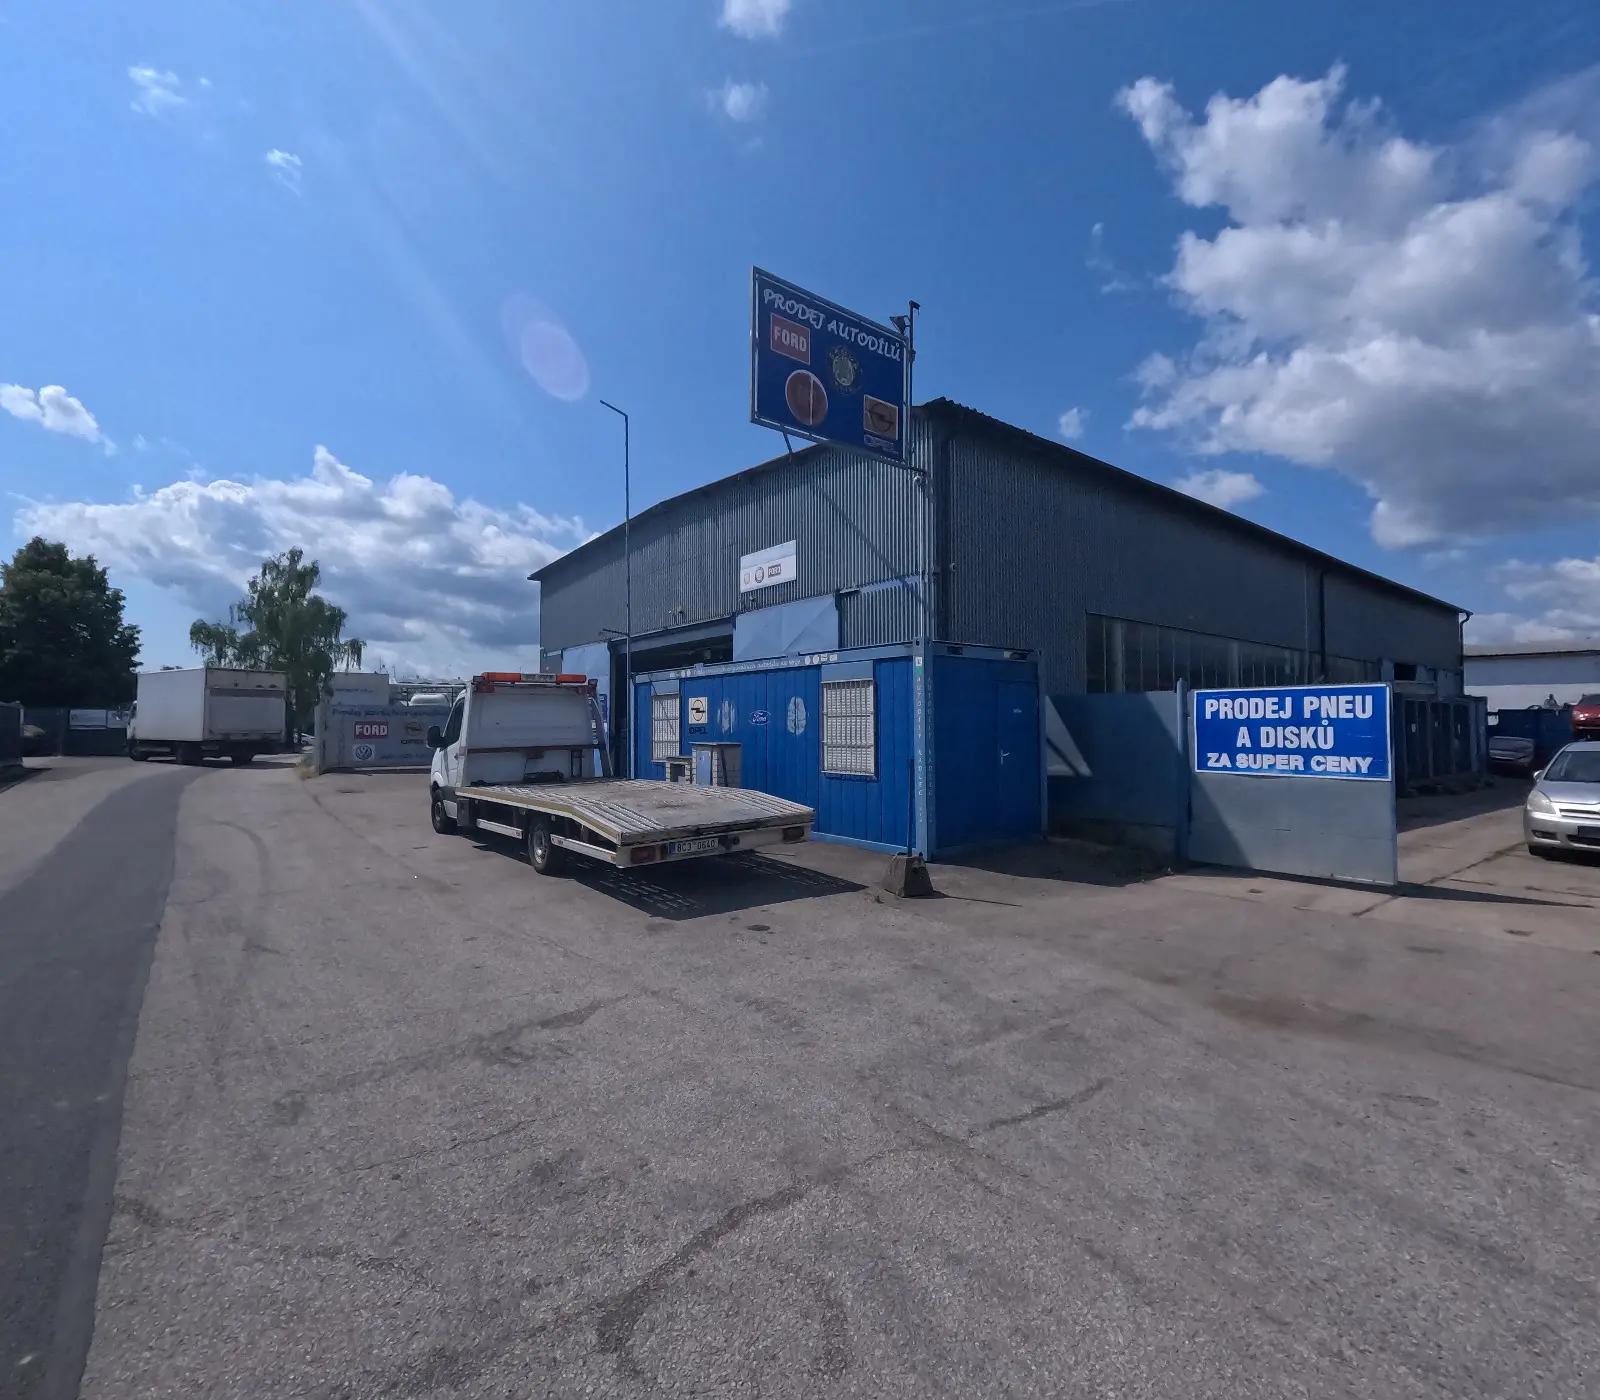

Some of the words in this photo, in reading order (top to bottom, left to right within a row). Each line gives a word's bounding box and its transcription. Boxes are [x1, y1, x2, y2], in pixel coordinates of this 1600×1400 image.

[763, 288, 825, 330] PRODEJ
[773, 325, 808, 353] FORD
[1205, 697, 1293, 720] PRODEJ
[1303, 695, 1373, 719] PNEU
[355, 724, 388, 736] FORD
[1236, 727, 1252, 748] A
[1260, 719, 1335, 750] DISKŮ
[1207, 752, 1232, 768] ZA
[1236, 753, 1305, 771] SUPER
[1310, 755, 1374, 774] CENY
